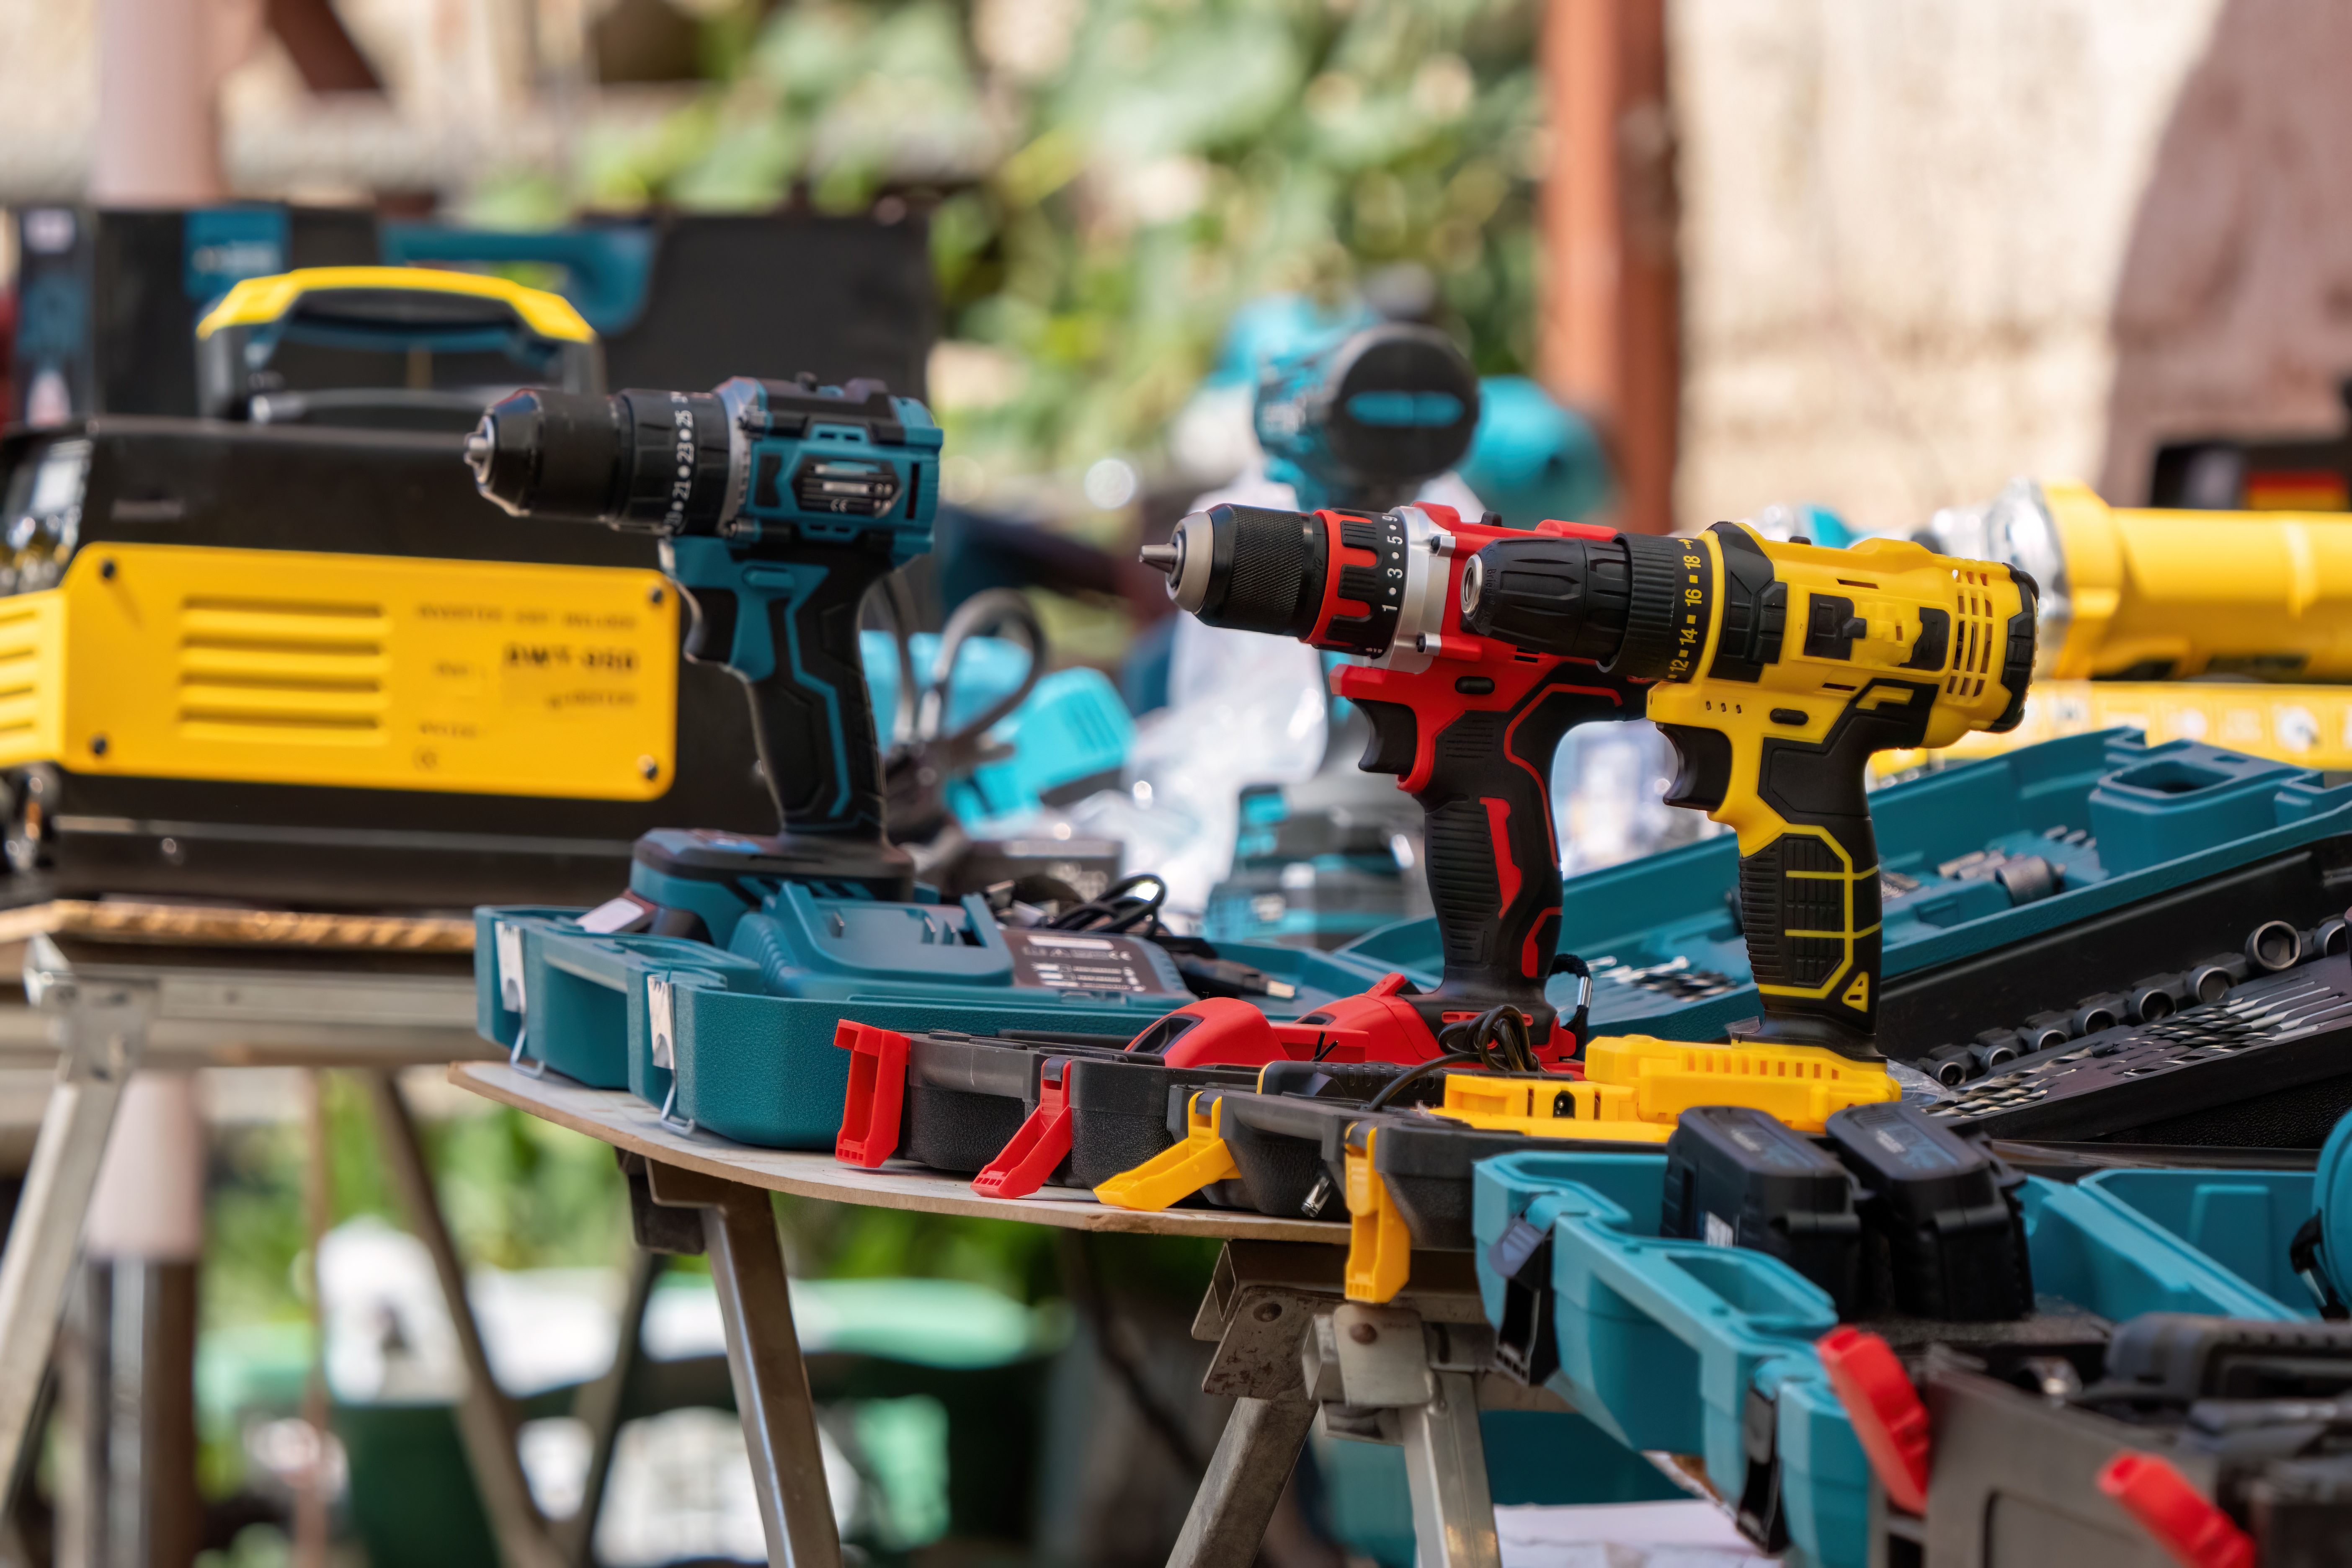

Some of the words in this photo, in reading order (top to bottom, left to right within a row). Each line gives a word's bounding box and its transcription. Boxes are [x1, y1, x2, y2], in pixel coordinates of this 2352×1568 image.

[674, 410, 694, 428] 25
[676, 441, 694, 464] 23
[672, 480, 692, 501] 21
[1387, 535, 1403, 545] 5
[1683, 555, 1702, 570] 18
[1387, 568, 1403, 579] 3
[1684, 588, 1702, 607] 16
[1679, 628, 1698, 645] 14
[1669, 659, 1690, 671] 12
